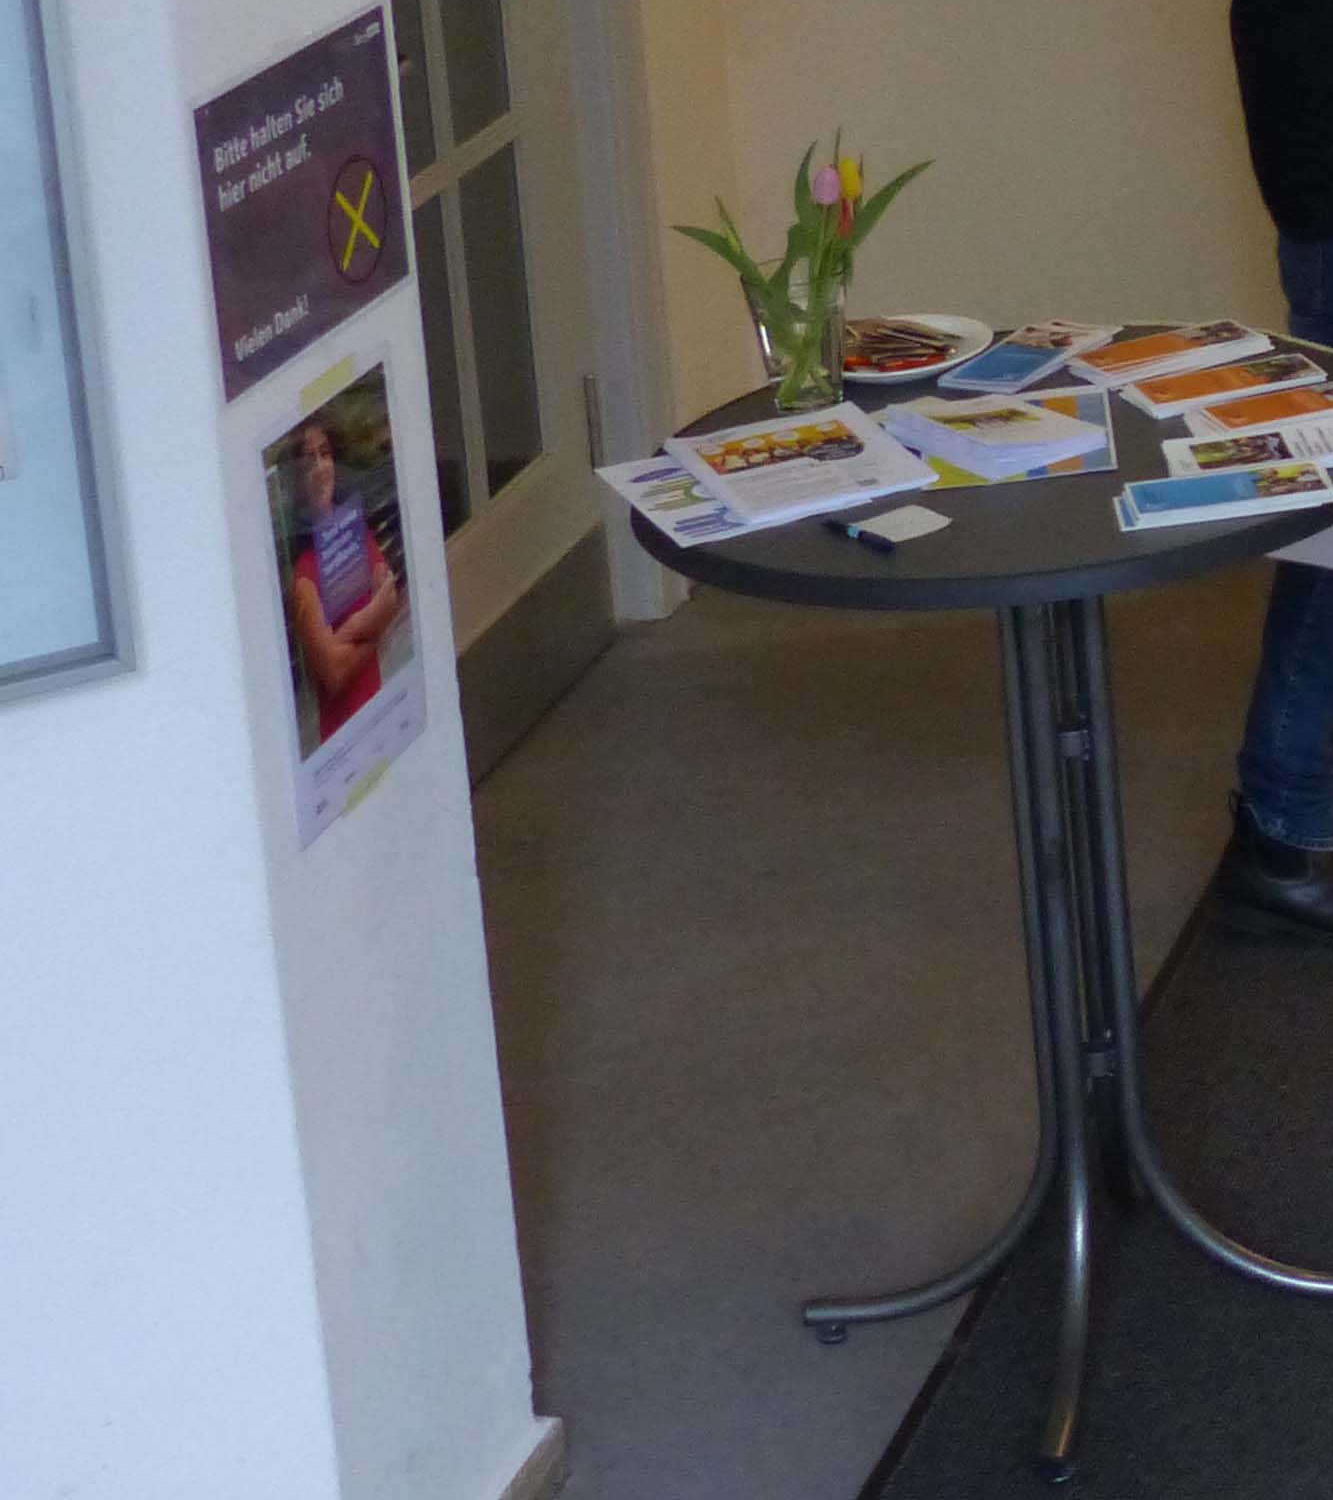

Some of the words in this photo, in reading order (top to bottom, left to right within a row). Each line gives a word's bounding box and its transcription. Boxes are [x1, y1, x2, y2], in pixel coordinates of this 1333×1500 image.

[214, 139, 249, 173] Bitte
[251, 111, 293, 150] halten
[295, 95, 315, 124] Sie
[317, 76, 344, 112] sich
[217, 178, 246, 212] hier
[249, 152, 283, 193] nicht
[285, 133, 311, 170] auf.
[235, 322, 272, 362] Vielen
[274, 293, 310, 335] Dank!
